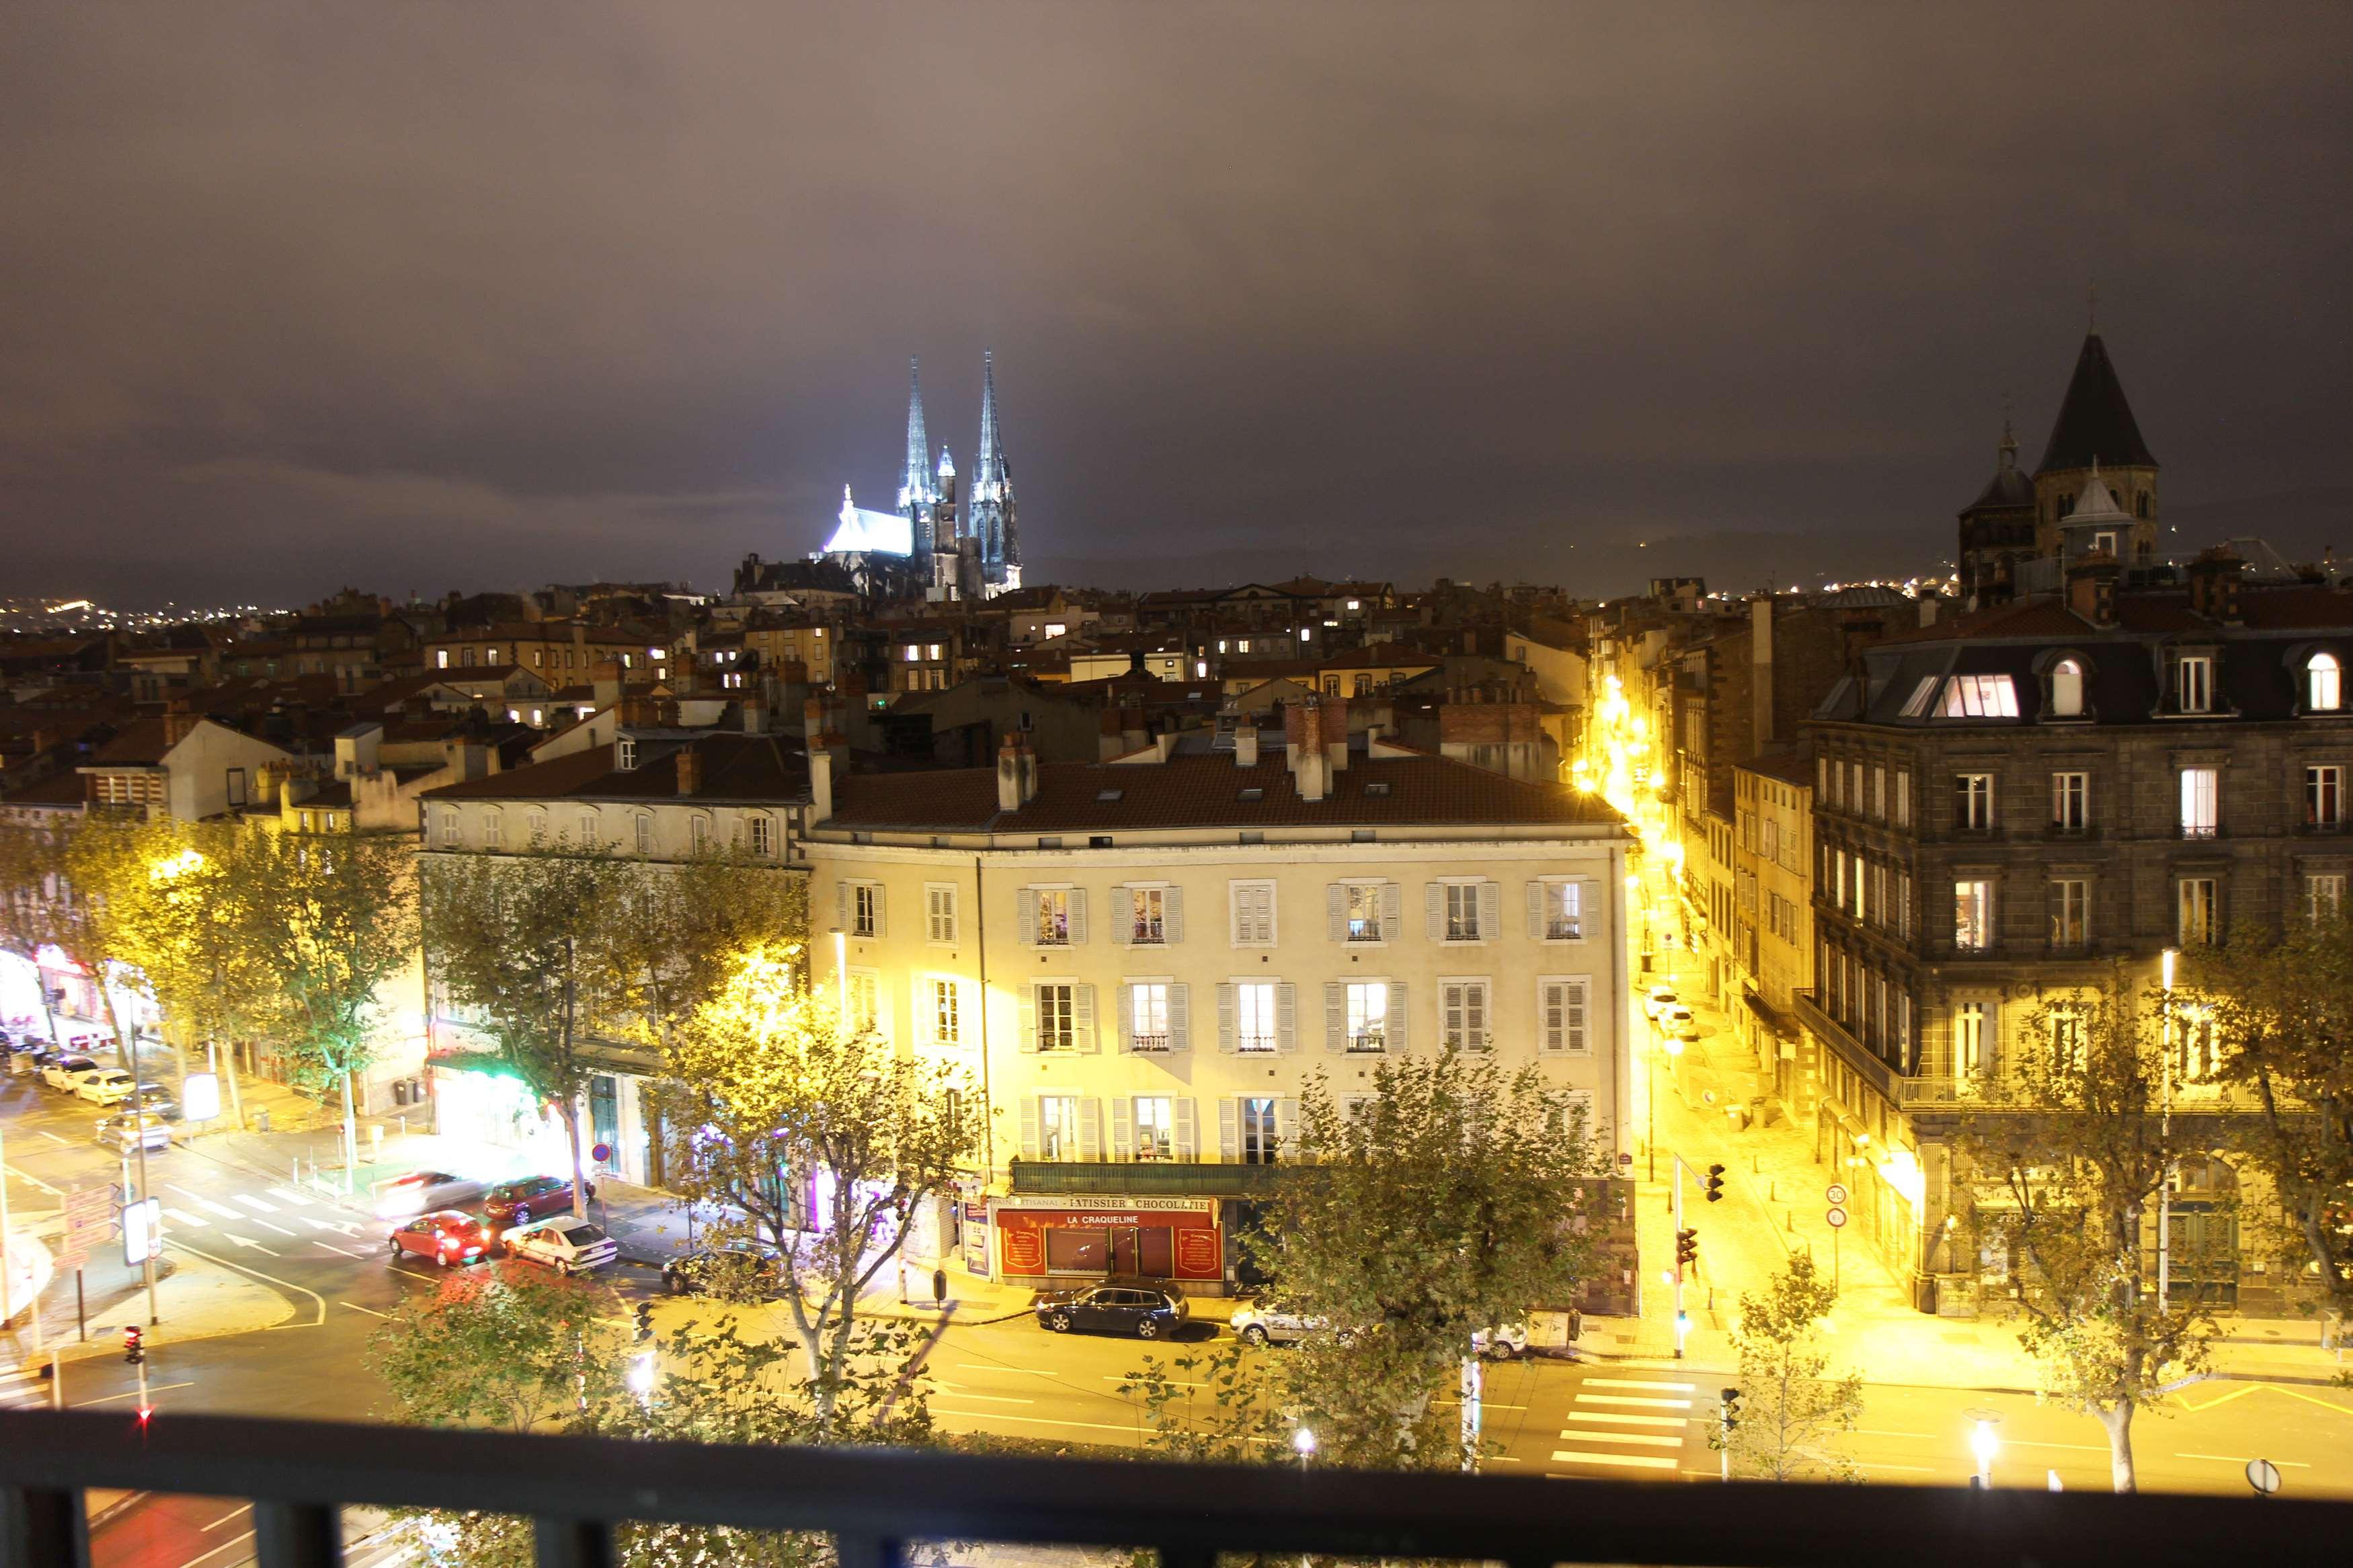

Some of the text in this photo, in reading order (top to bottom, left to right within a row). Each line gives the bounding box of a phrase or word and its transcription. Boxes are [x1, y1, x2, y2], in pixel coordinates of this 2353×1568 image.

[1830, 1190, 1843, 1200] 30
[1067, 1215, 1139, 1224] LA CRAQUELINE
